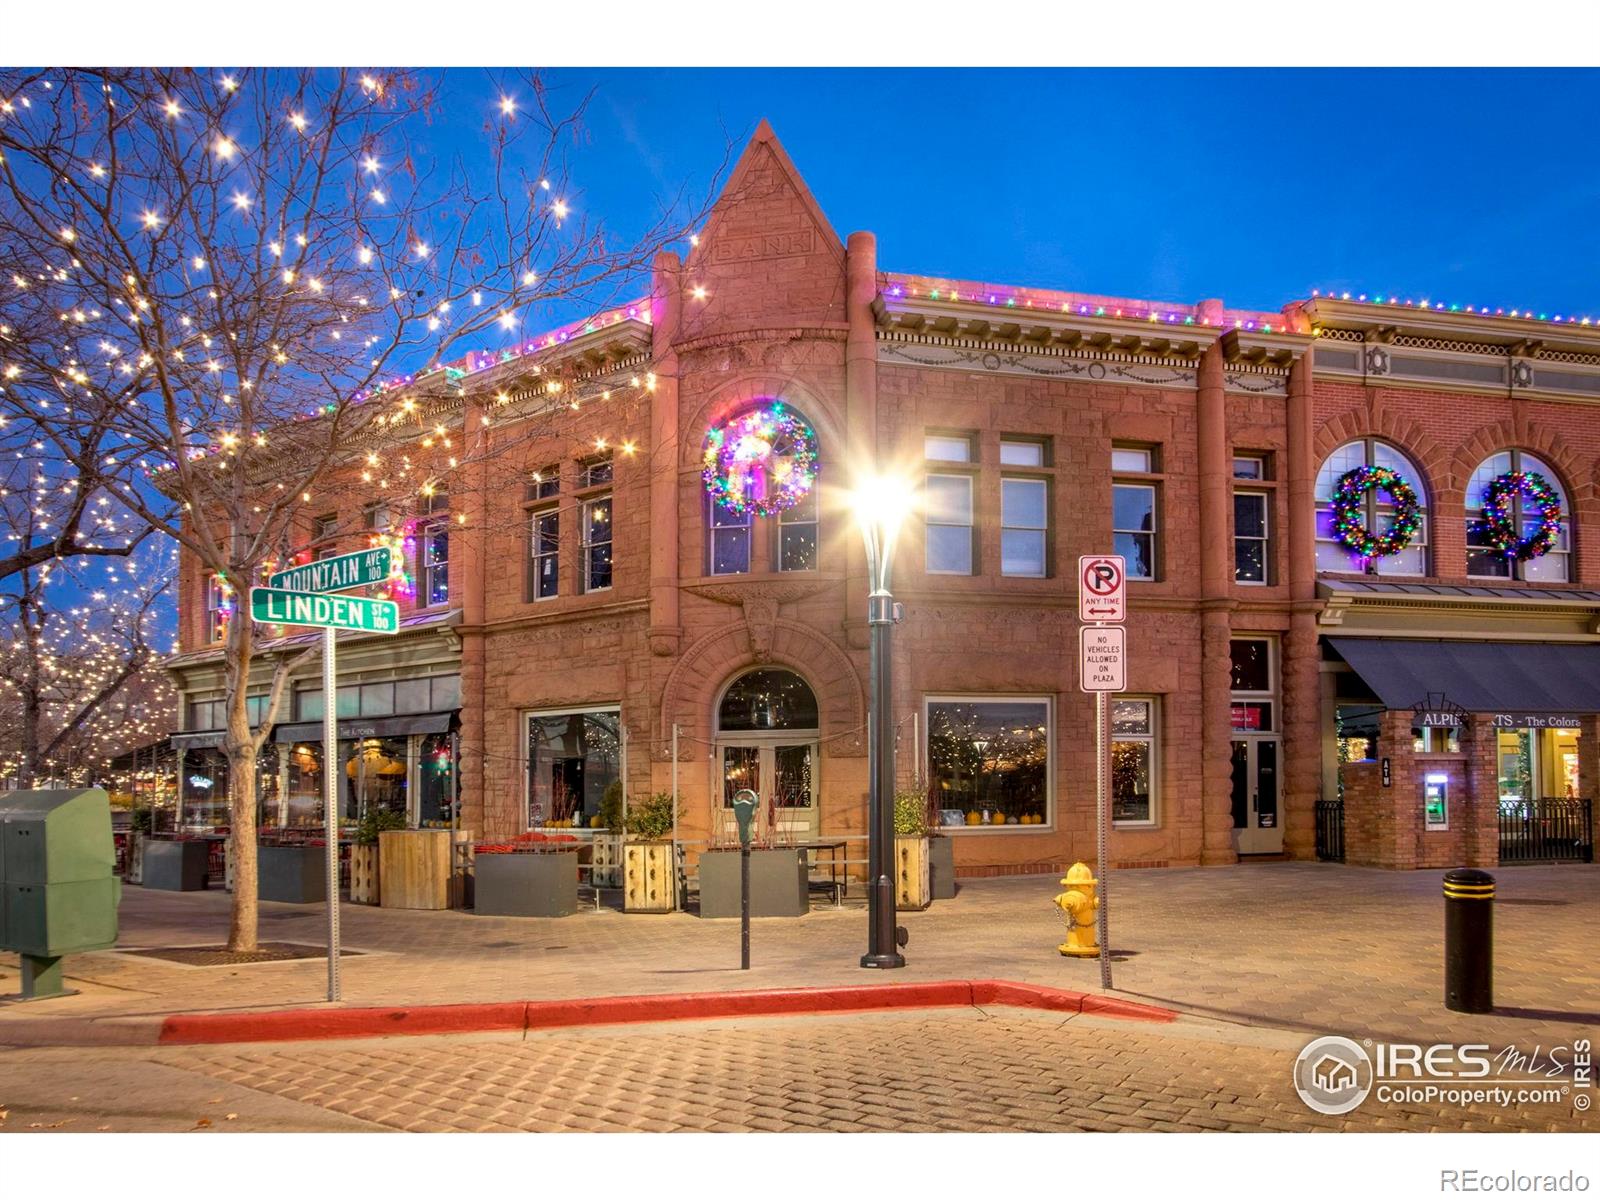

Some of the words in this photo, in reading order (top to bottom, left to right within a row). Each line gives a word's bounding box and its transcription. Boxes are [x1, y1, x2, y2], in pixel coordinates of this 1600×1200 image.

[717, 231, 811, 260] BANK
[282, 557, 359, 591] MOUNTAIN
[365, 551, 381, 567] AVE
[368, 566, 382, 581] 100
[267, 593, 363, 626] LINDEN
[371, 603, 383, 616] ST
[373, 617, 389, 629] 100
[1098, 665, 1109, 673] ON
[1525, 716, 1546, 726] The
